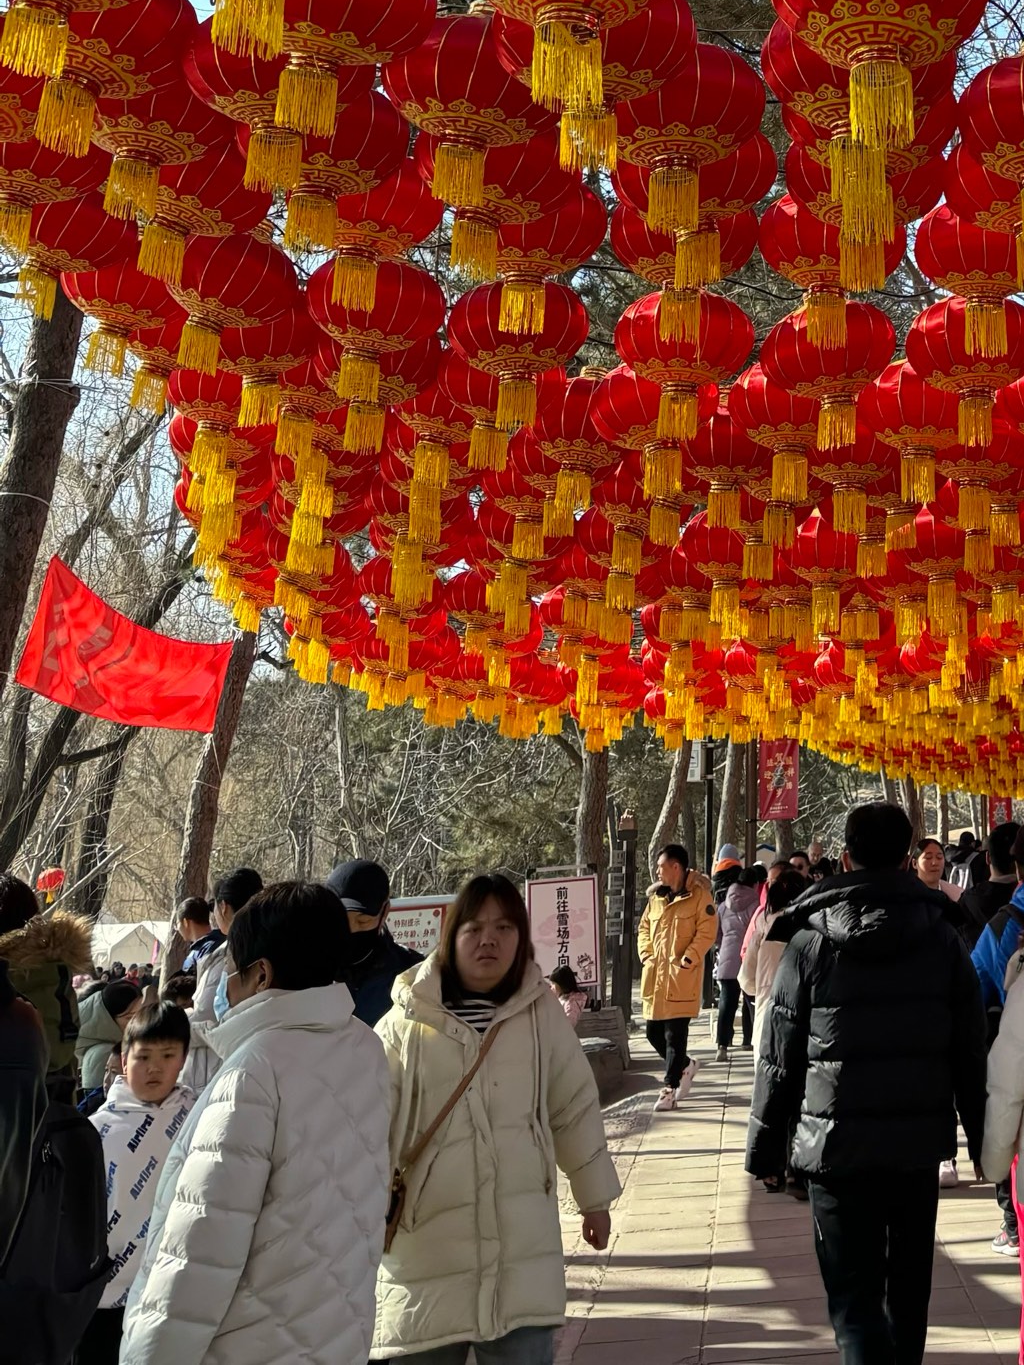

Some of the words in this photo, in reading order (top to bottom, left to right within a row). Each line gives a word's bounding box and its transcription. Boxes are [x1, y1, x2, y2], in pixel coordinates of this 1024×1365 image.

[394, 918, 421, 928] 特别提示
[556, 886, 570, 969] 前往雪场方向
[127, 1114, 155, 1153] Airfirst
[130, 1155, 158, 1200] Airfirst
